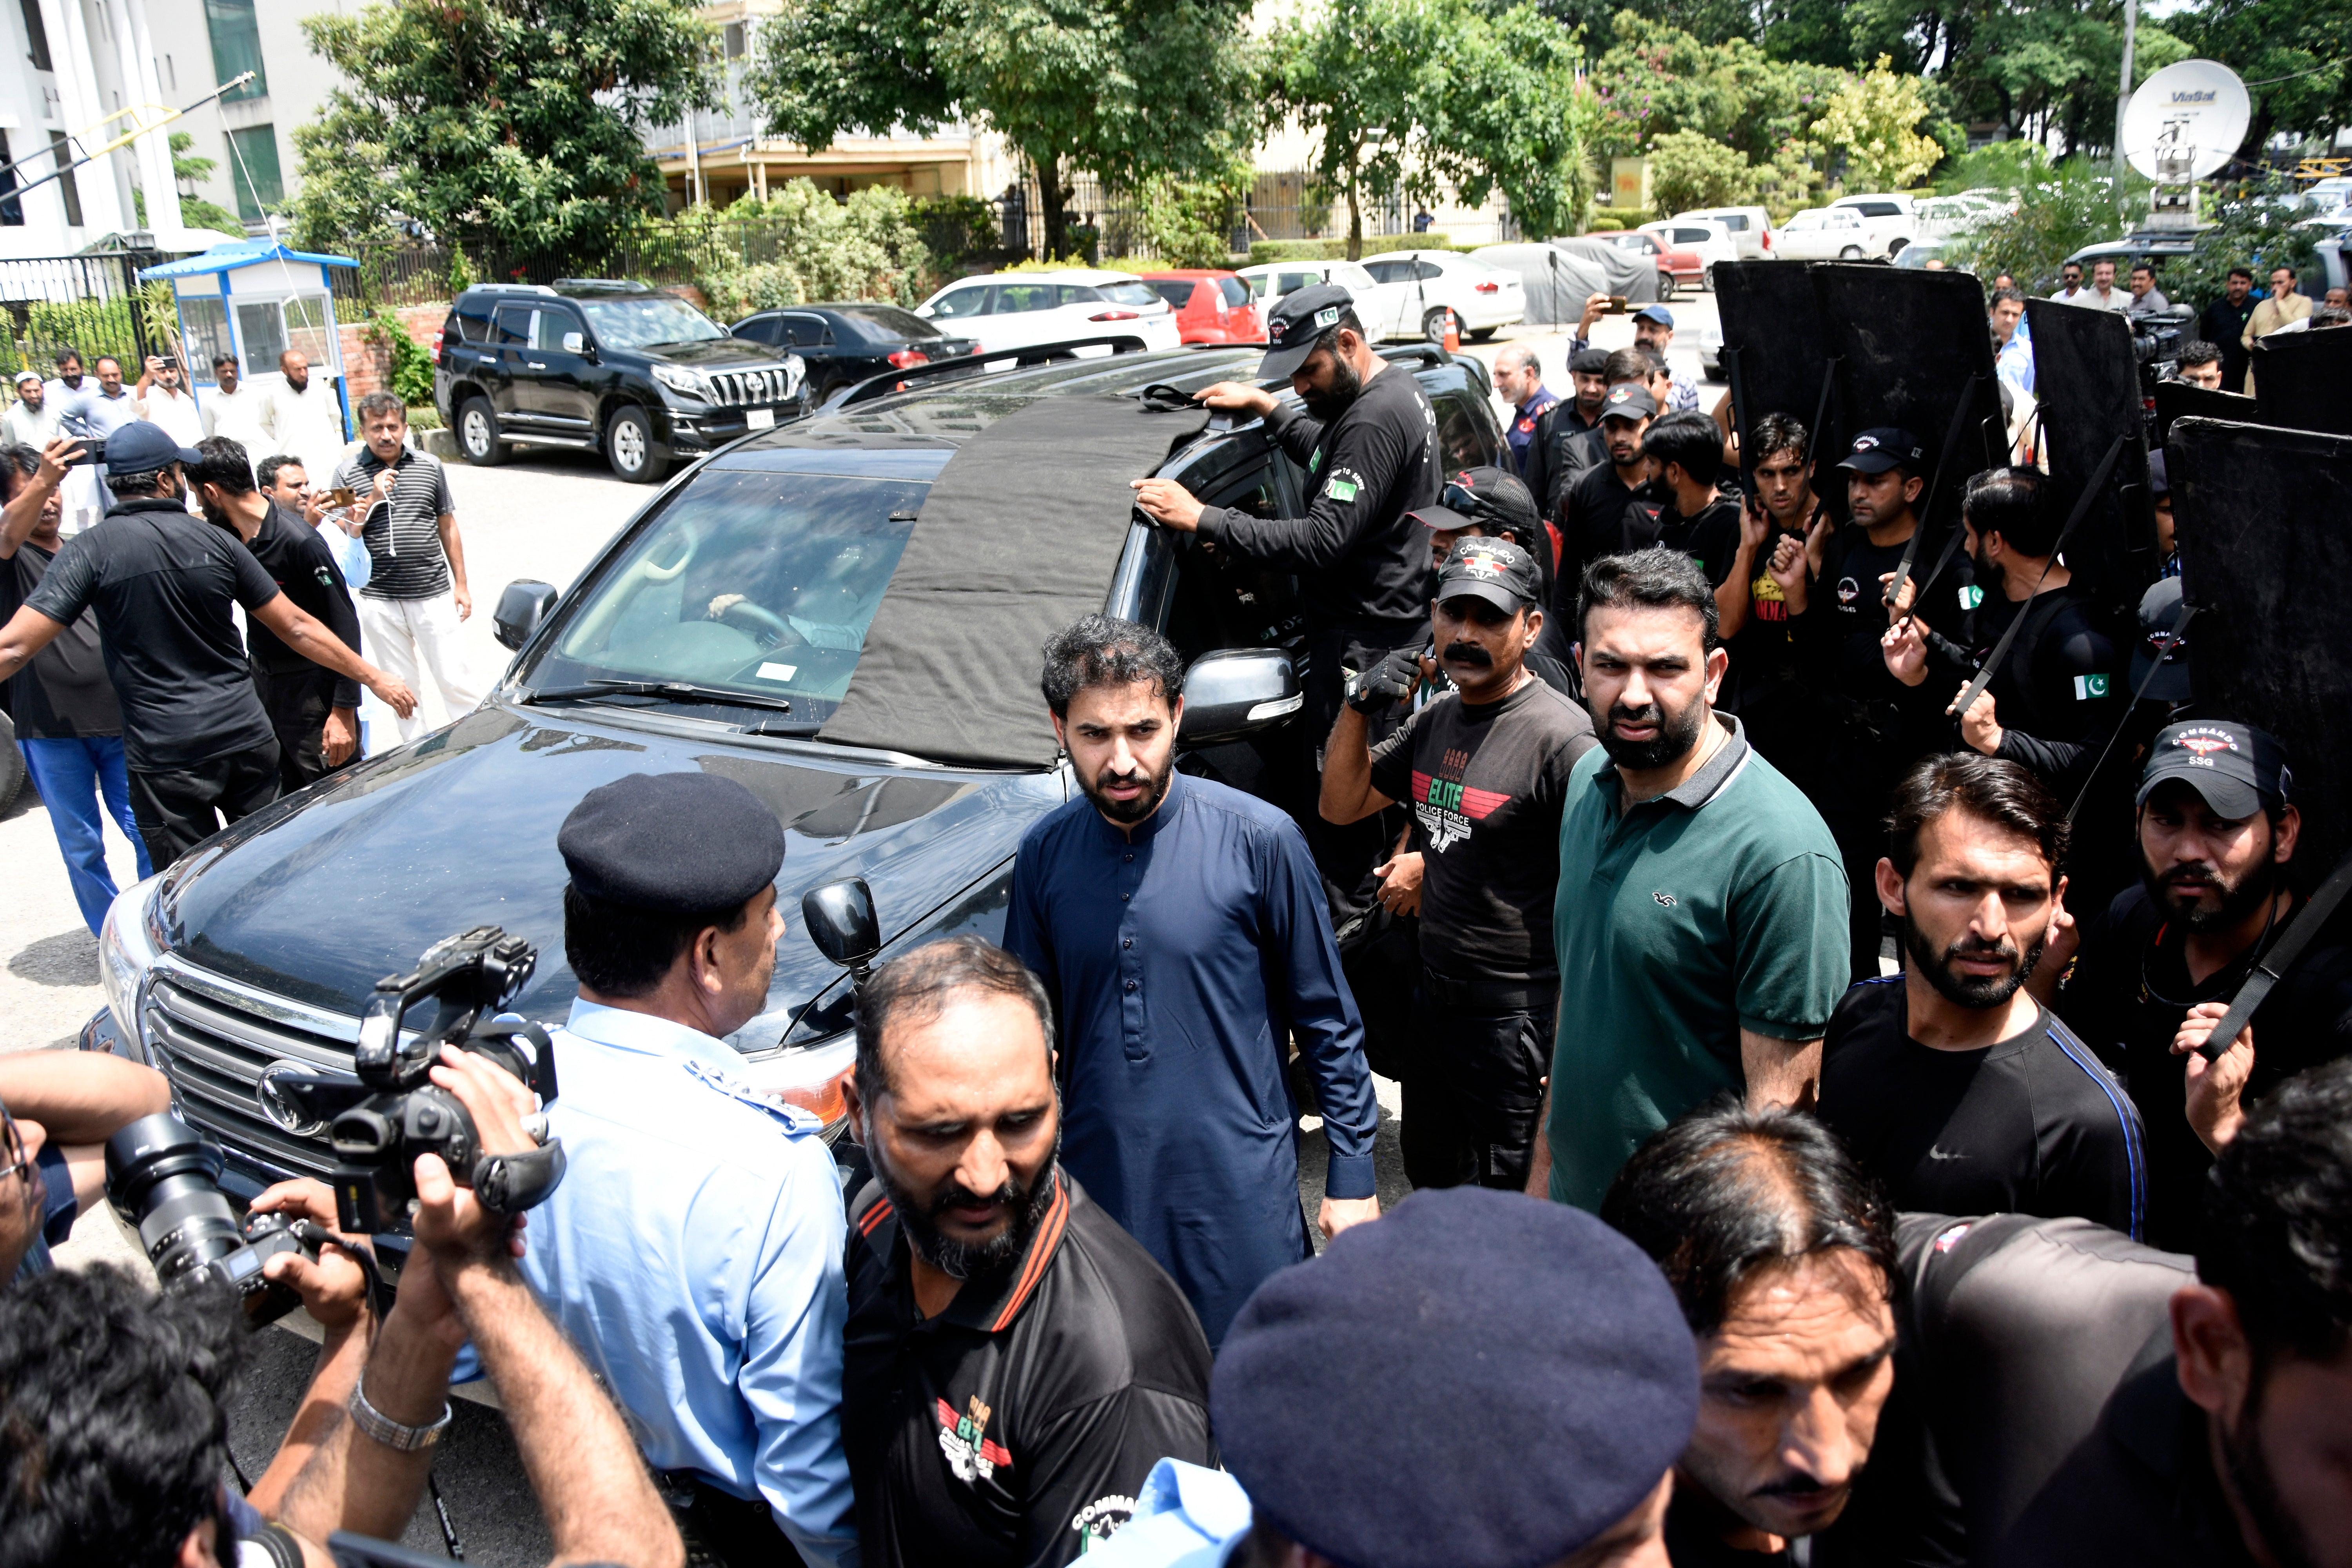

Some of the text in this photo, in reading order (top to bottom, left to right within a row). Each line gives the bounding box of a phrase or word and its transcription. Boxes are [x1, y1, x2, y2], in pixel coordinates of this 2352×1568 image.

[1460, 544, 1515, 564] COMMANDO
[2172, 728, 2238, 750] COMMANDO
[2189, 756, 2214, 766] SSG
[1428, 778, 1463, 811] ELITE
[1416, 801, 1469, 826] POLICE FORCE
